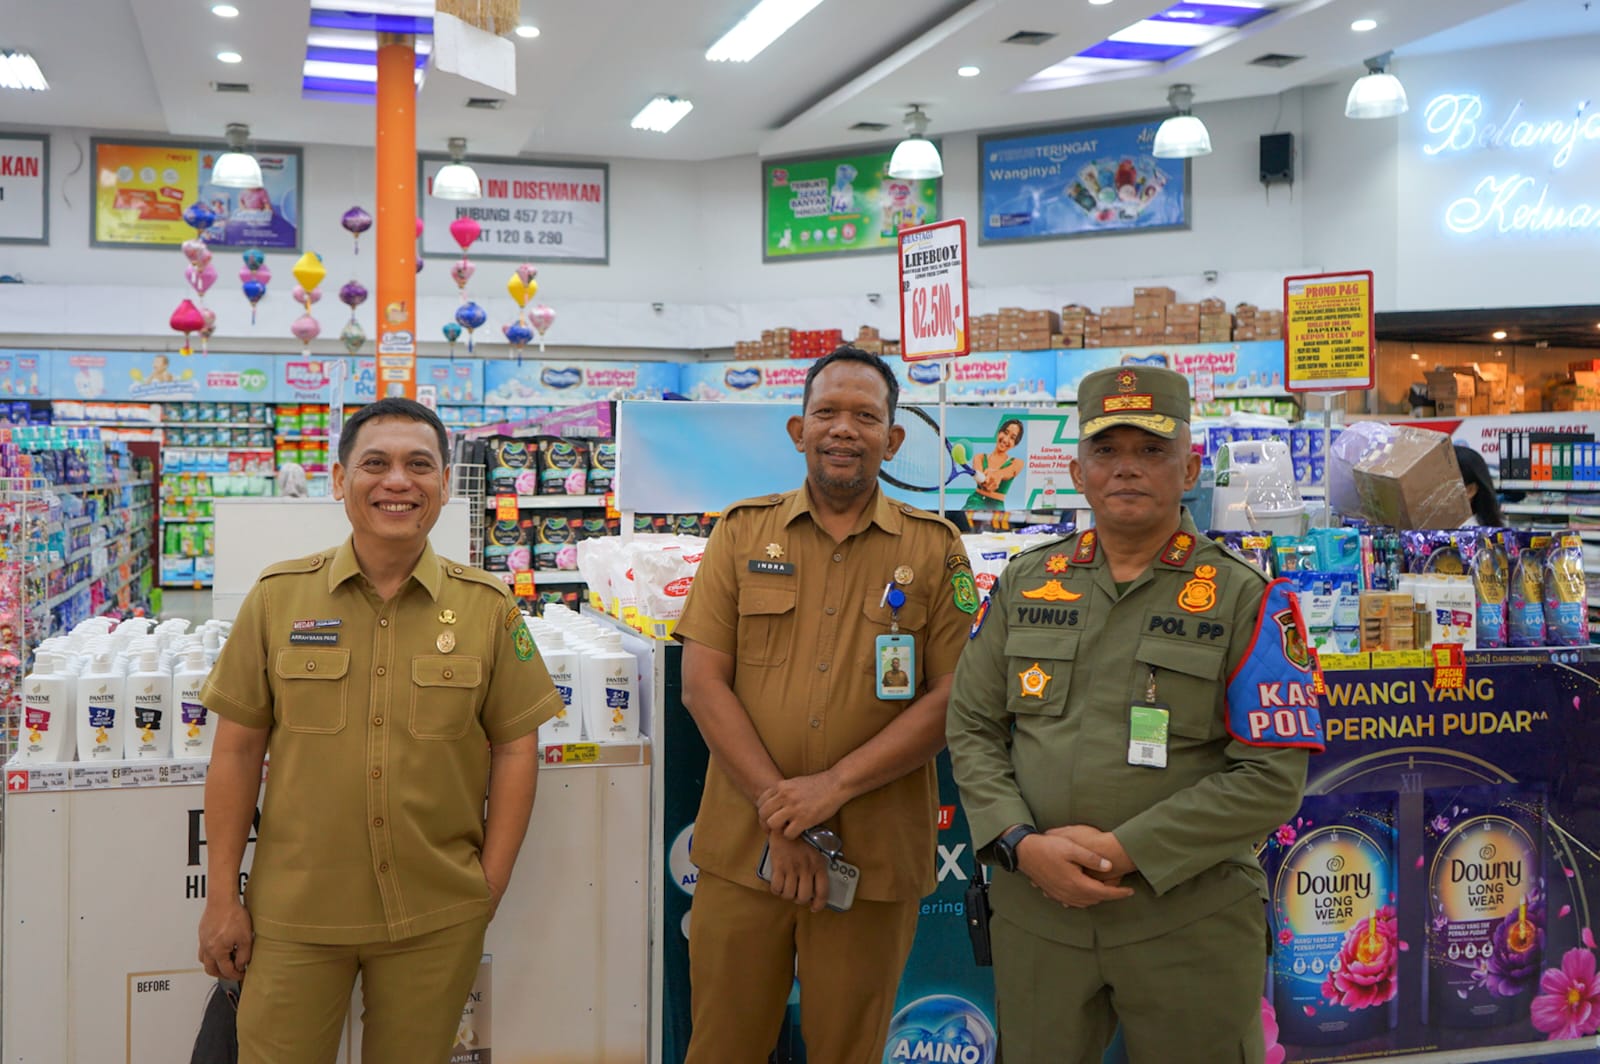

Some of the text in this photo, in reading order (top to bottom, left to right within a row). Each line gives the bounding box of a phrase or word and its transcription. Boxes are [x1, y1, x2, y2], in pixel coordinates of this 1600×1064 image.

[1423, 93, 1600, 168] Belanja
[990, 162, 1061, 180] Wanginya!
[488, 178, 508, 199] INI
[513, 180, 601, 203] DISEWAKAN
[1445, 172, 1600, 233] Kelua
[456, 206, 573, 225] HUBUNGI 457 2371
[475, 229, 490, 243] XT
[496, 230, 519, 243] 120
[905, 244, 959, 269] LIFEBUOY
[1306, 283, 1359, 298] PROMO P&G
[1307, 326, 1351, 334] DAPATKAN
[954, 360, 1007, 372] Lembut
[1174, 351, 1236, 366] Lembut
[586, 367, 635, 379] Lembut
[208, 379, 238, 388] EXTRA
[757, 562, 785, 571] INDRA
[1017, 606, 1079, 626] YUNUS
[1149, 614, 1224, 640] POL PP
[1437, 667, 1463, 678] SPECIAL
[1435, 677, 1462, 688] PRICE
[1325, 679, 1415, 707] WANGI
[1422, 678, 1494, 703] YANG
[1326, 714, 1435, 742] PERNAH
[1452, 859, 1521, 887] Downy
[1297, 871, 1371, 899] Downy
[1468, 883, 1504, 896] LONG
[1315, 896, 1353, 909] LONG
[1468, 894, 1505, 906] WEAR
[918, 900, 963, 917] ering
[1315, 907, 1353, 920] WEAR
[137, 980, 170, 993] BEFORE
[451, 1054, 472, 1064] AMIN
[893, 1039, 980, 1064] AMINO
